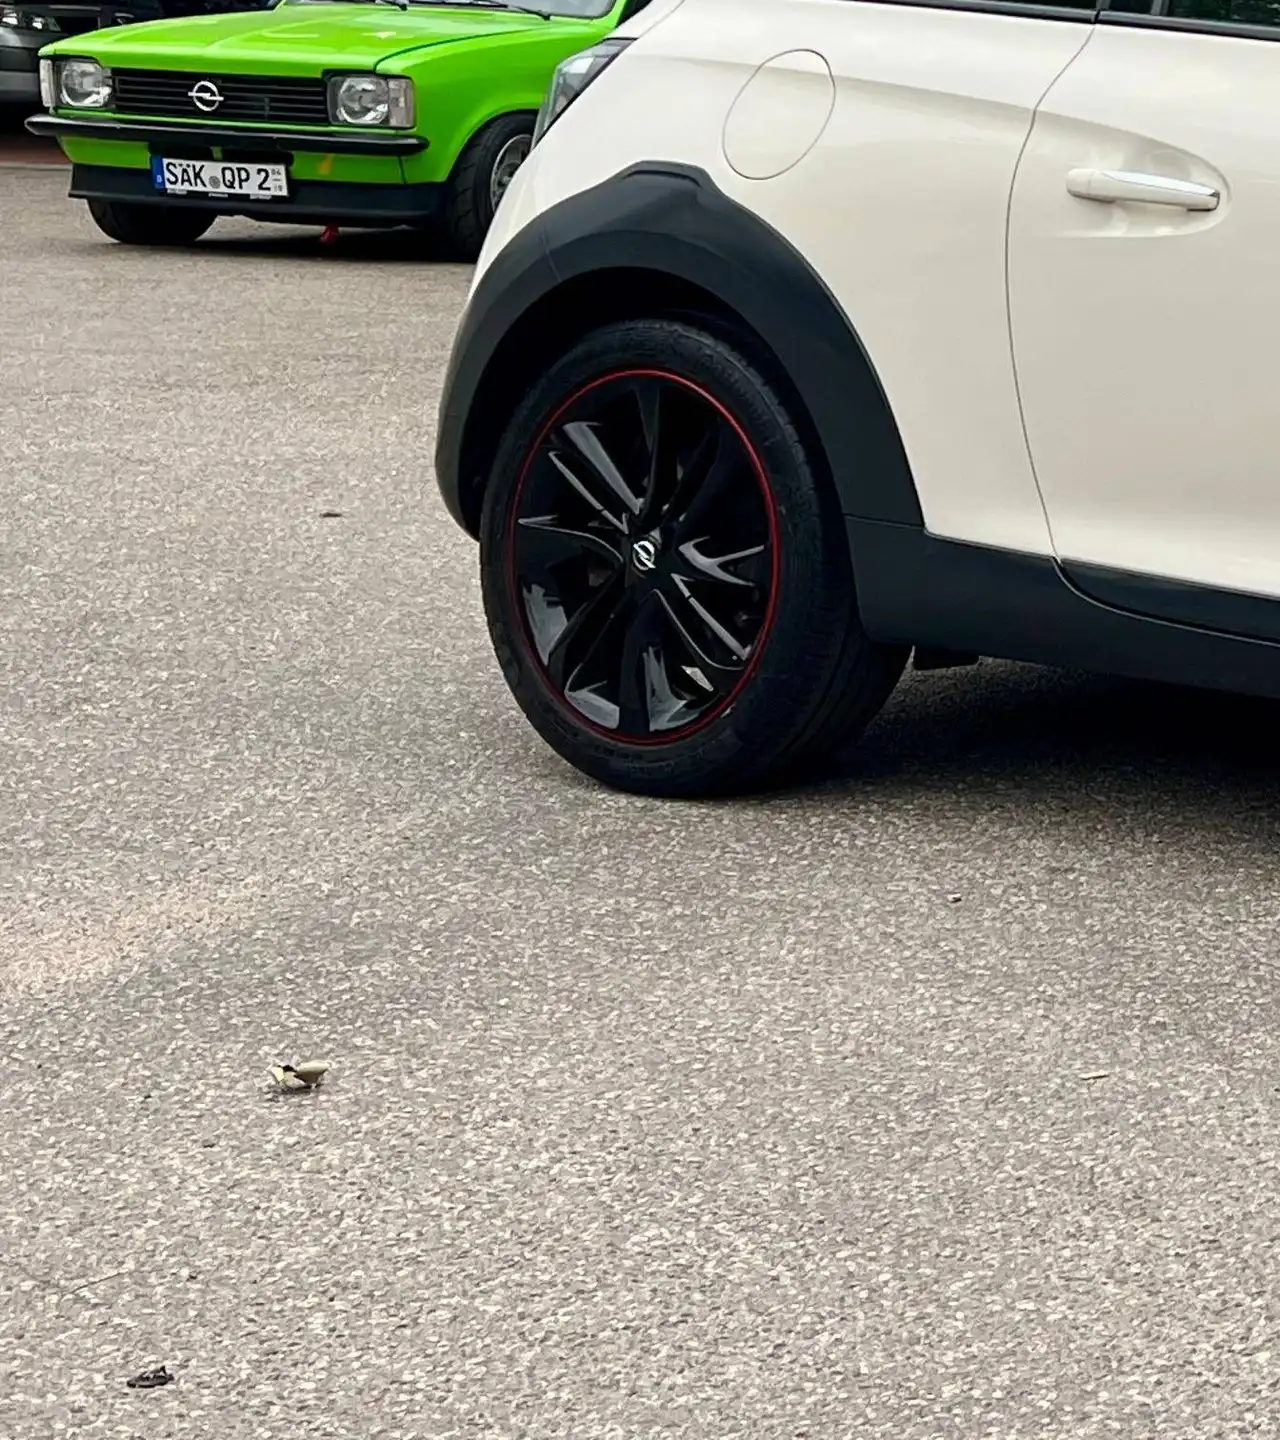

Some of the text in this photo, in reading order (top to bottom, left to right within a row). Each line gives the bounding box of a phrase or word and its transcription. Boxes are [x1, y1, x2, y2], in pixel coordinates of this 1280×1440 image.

[166, 161, 207, 187] SÄK
[221, 166, 250, 189] QP
[256, 168, 271, 191] 2
